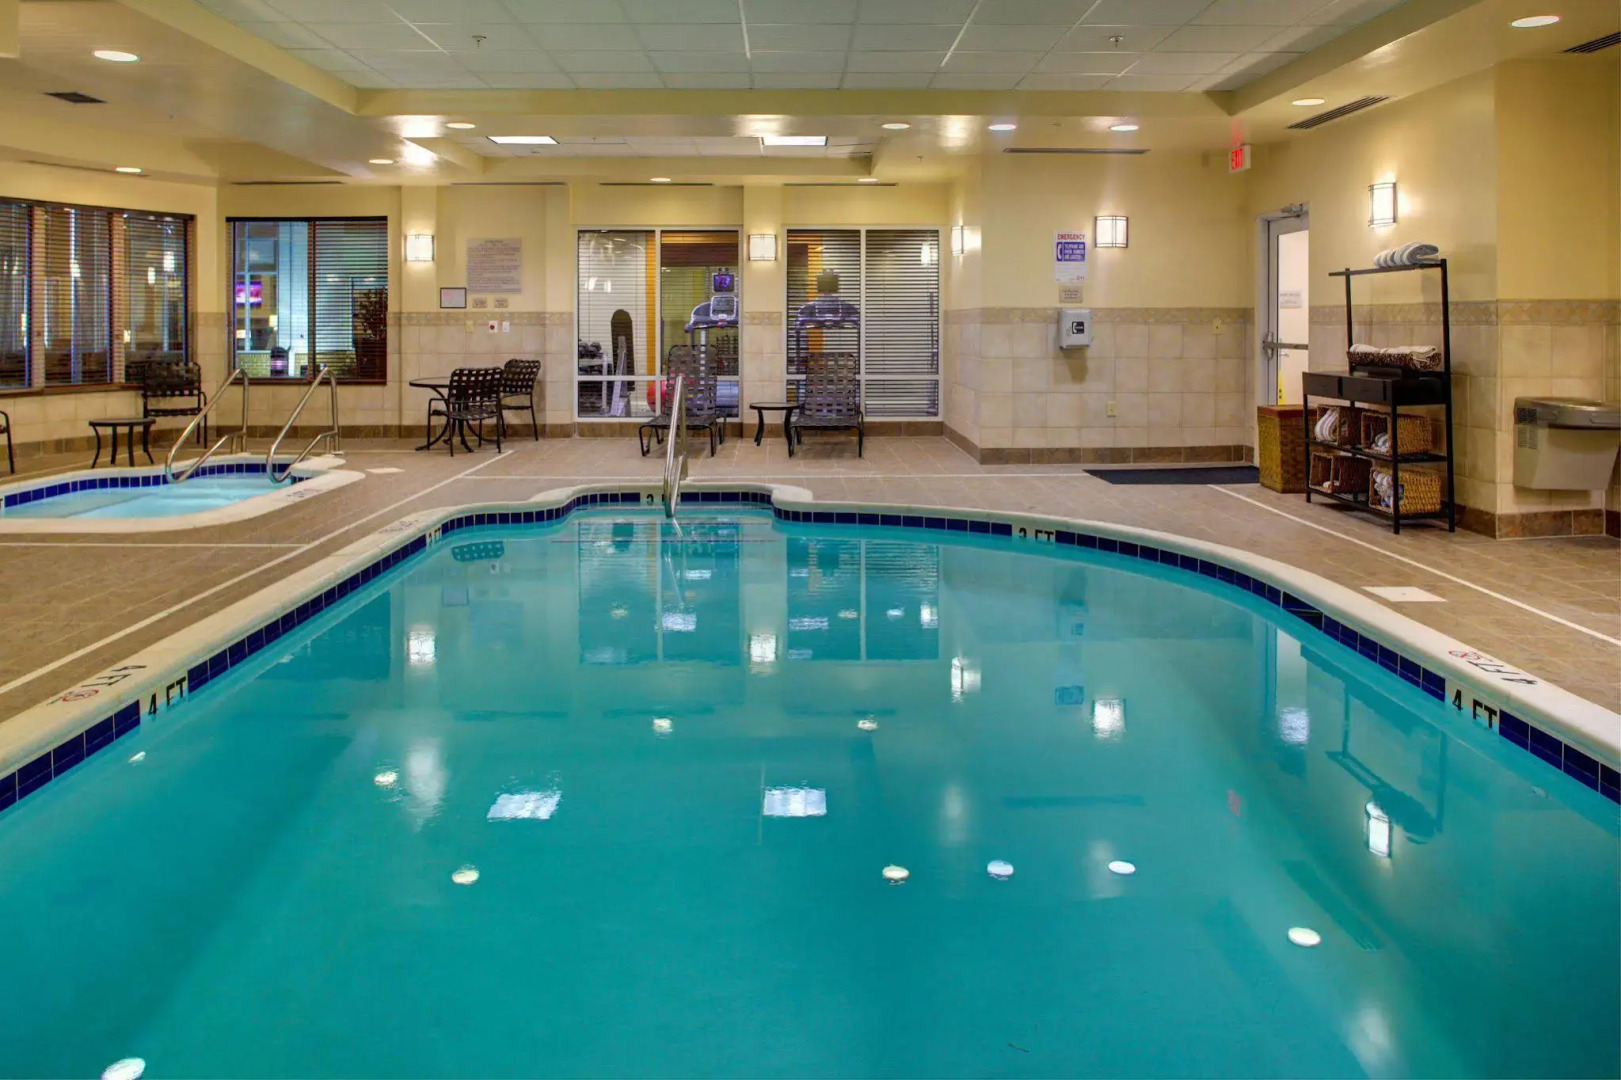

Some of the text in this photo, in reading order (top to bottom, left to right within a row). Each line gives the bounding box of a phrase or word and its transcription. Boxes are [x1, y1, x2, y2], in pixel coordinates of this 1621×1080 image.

[1034, 529, 1055, 541] FT
[147, 675, 187, 716] 4 FT
[1452, 689, 1498, 729] 4 FT
